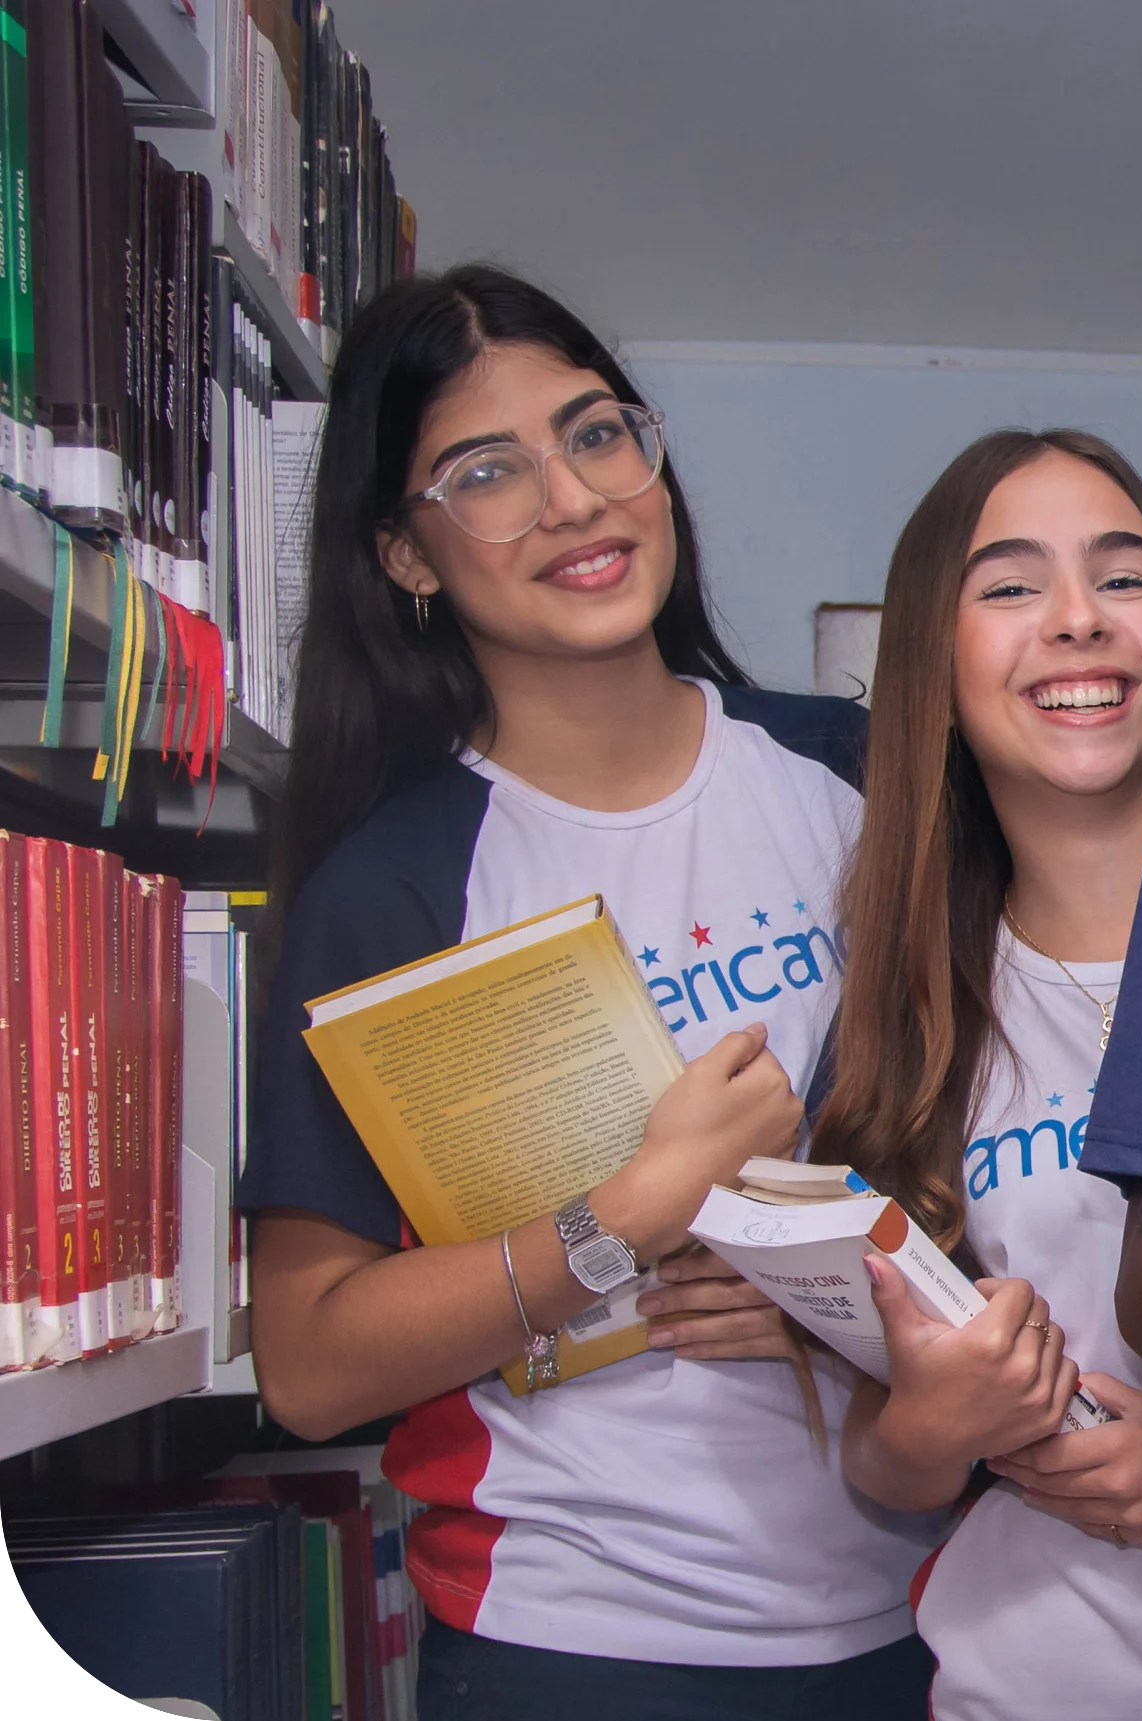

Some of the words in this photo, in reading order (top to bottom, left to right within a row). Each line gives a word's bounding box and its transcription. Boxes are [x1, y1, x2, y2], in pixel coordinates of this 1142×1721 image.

[17, 168, 25, 222] PENAL
[19, 227, 27, 294] CÓDIGO
[167, 276, 175, 354] PENAL
[12, 859, 20, 906] Capez
[12, 911, 20, 983] Fernando
[647, 920, 850, 1033] erican
[20, 1042, 28, 1094] PENAL
[60, 1011, 69, 1087] PENAL
[88, 1012, 98, 1087] PENAL
[57, 1091, 65, 1117] DE
[87, 1090, 95, 1115] DE
[21, 1099, 30, 1172] DIREITO
[58, 1120, 66, 1192] CURSO
[63, 1092, 72, 1190] DIREITO
[92, 1092, 100, 1187] DIREITO
[25, 1244, 31, 1270] 2
[64, 1232, 73, 1274] 2
[93, 1228, 100, 1263] 3
[118, 1234, 124, 1262] 3
[134, 1234, 139, 1258] 3
[168, 1225, 173, 1247] 3
[755, 1270, 815, 1288] PROCESSO
[814, 1274, 851, 1287] CIVIL
[907, 1247, 937, 1279] TARTUCE
[787, 1292, 832, 1308] DIREITO
[831, 1296, 855, 1308] DE
[809, 1306, 859, 1321] FAMÍLIA
[935, 1275, 969, 1313] FERNANDA
